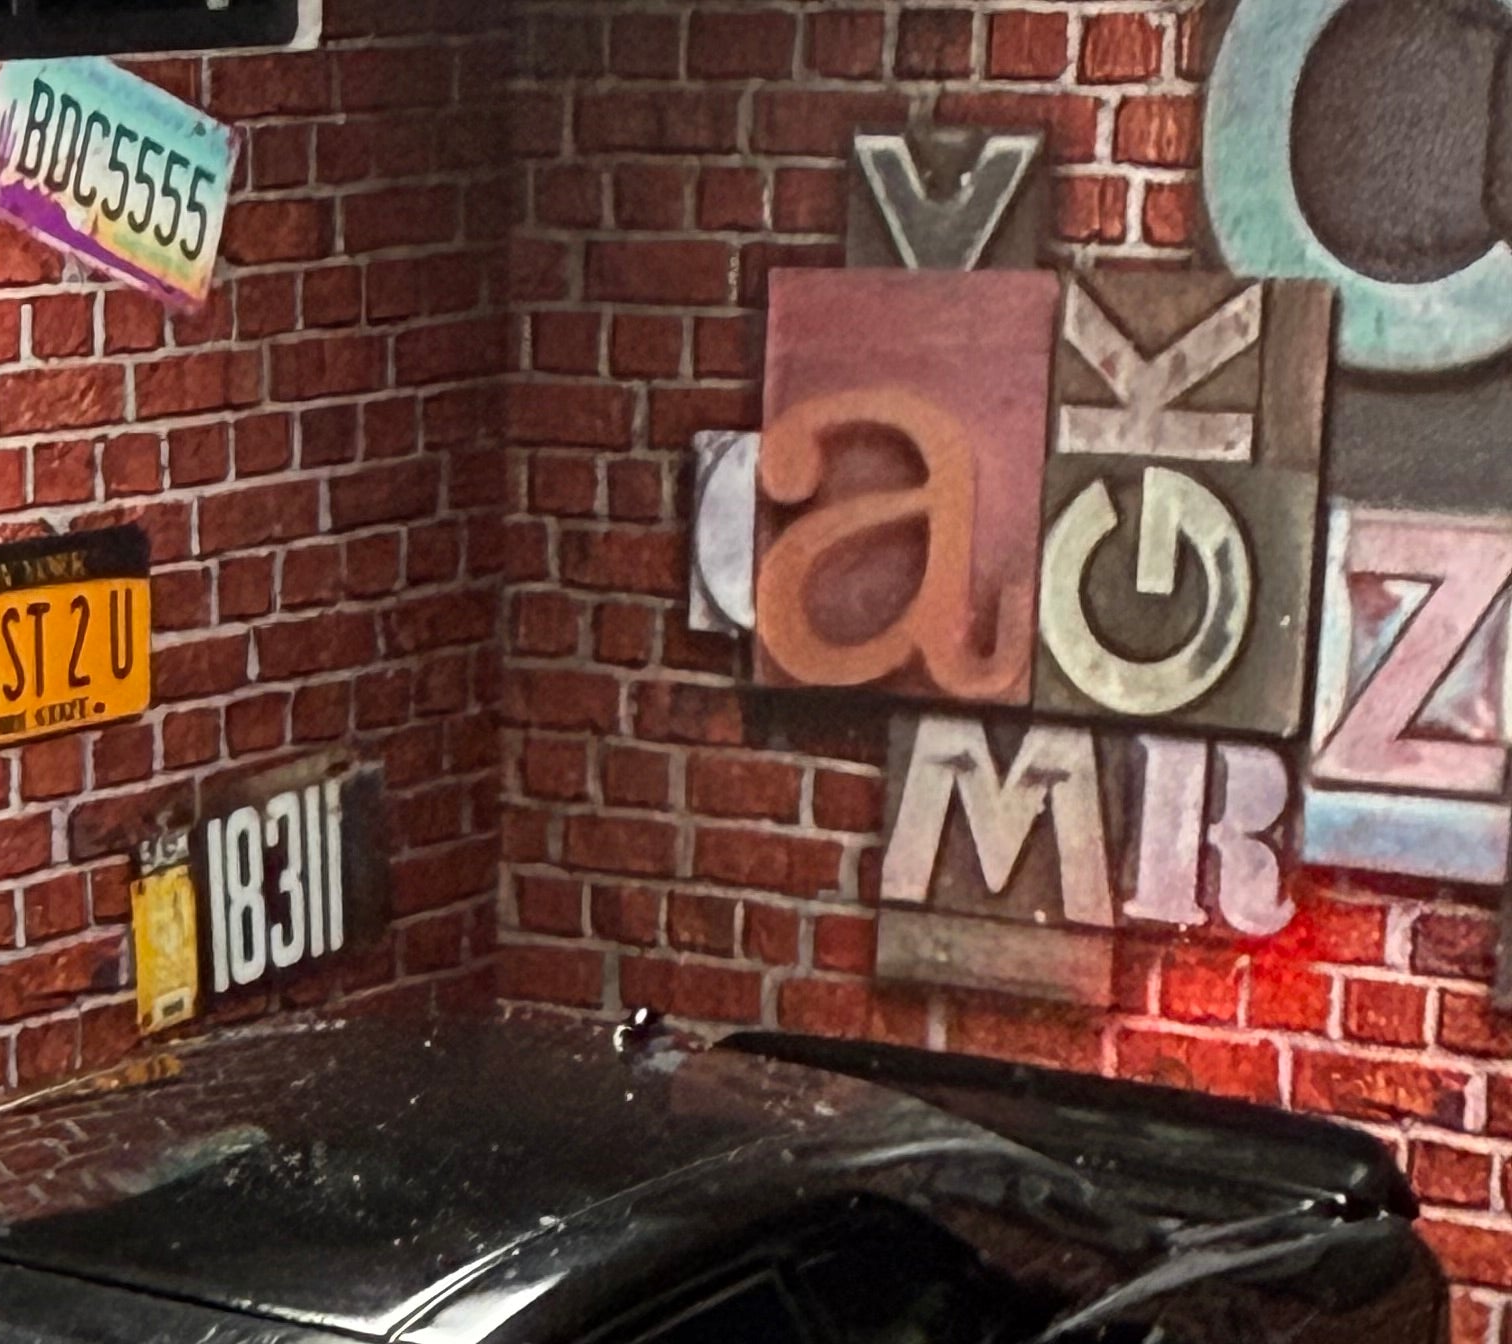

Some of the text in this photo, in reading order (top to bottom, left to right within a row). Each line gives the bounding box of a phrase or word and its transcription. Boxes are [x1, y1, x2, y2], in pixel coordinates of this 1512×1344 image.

[68, 595, 91, 688] 2
[110, 588, 133, 680] U
[207, 779, 344, 993] 18311
